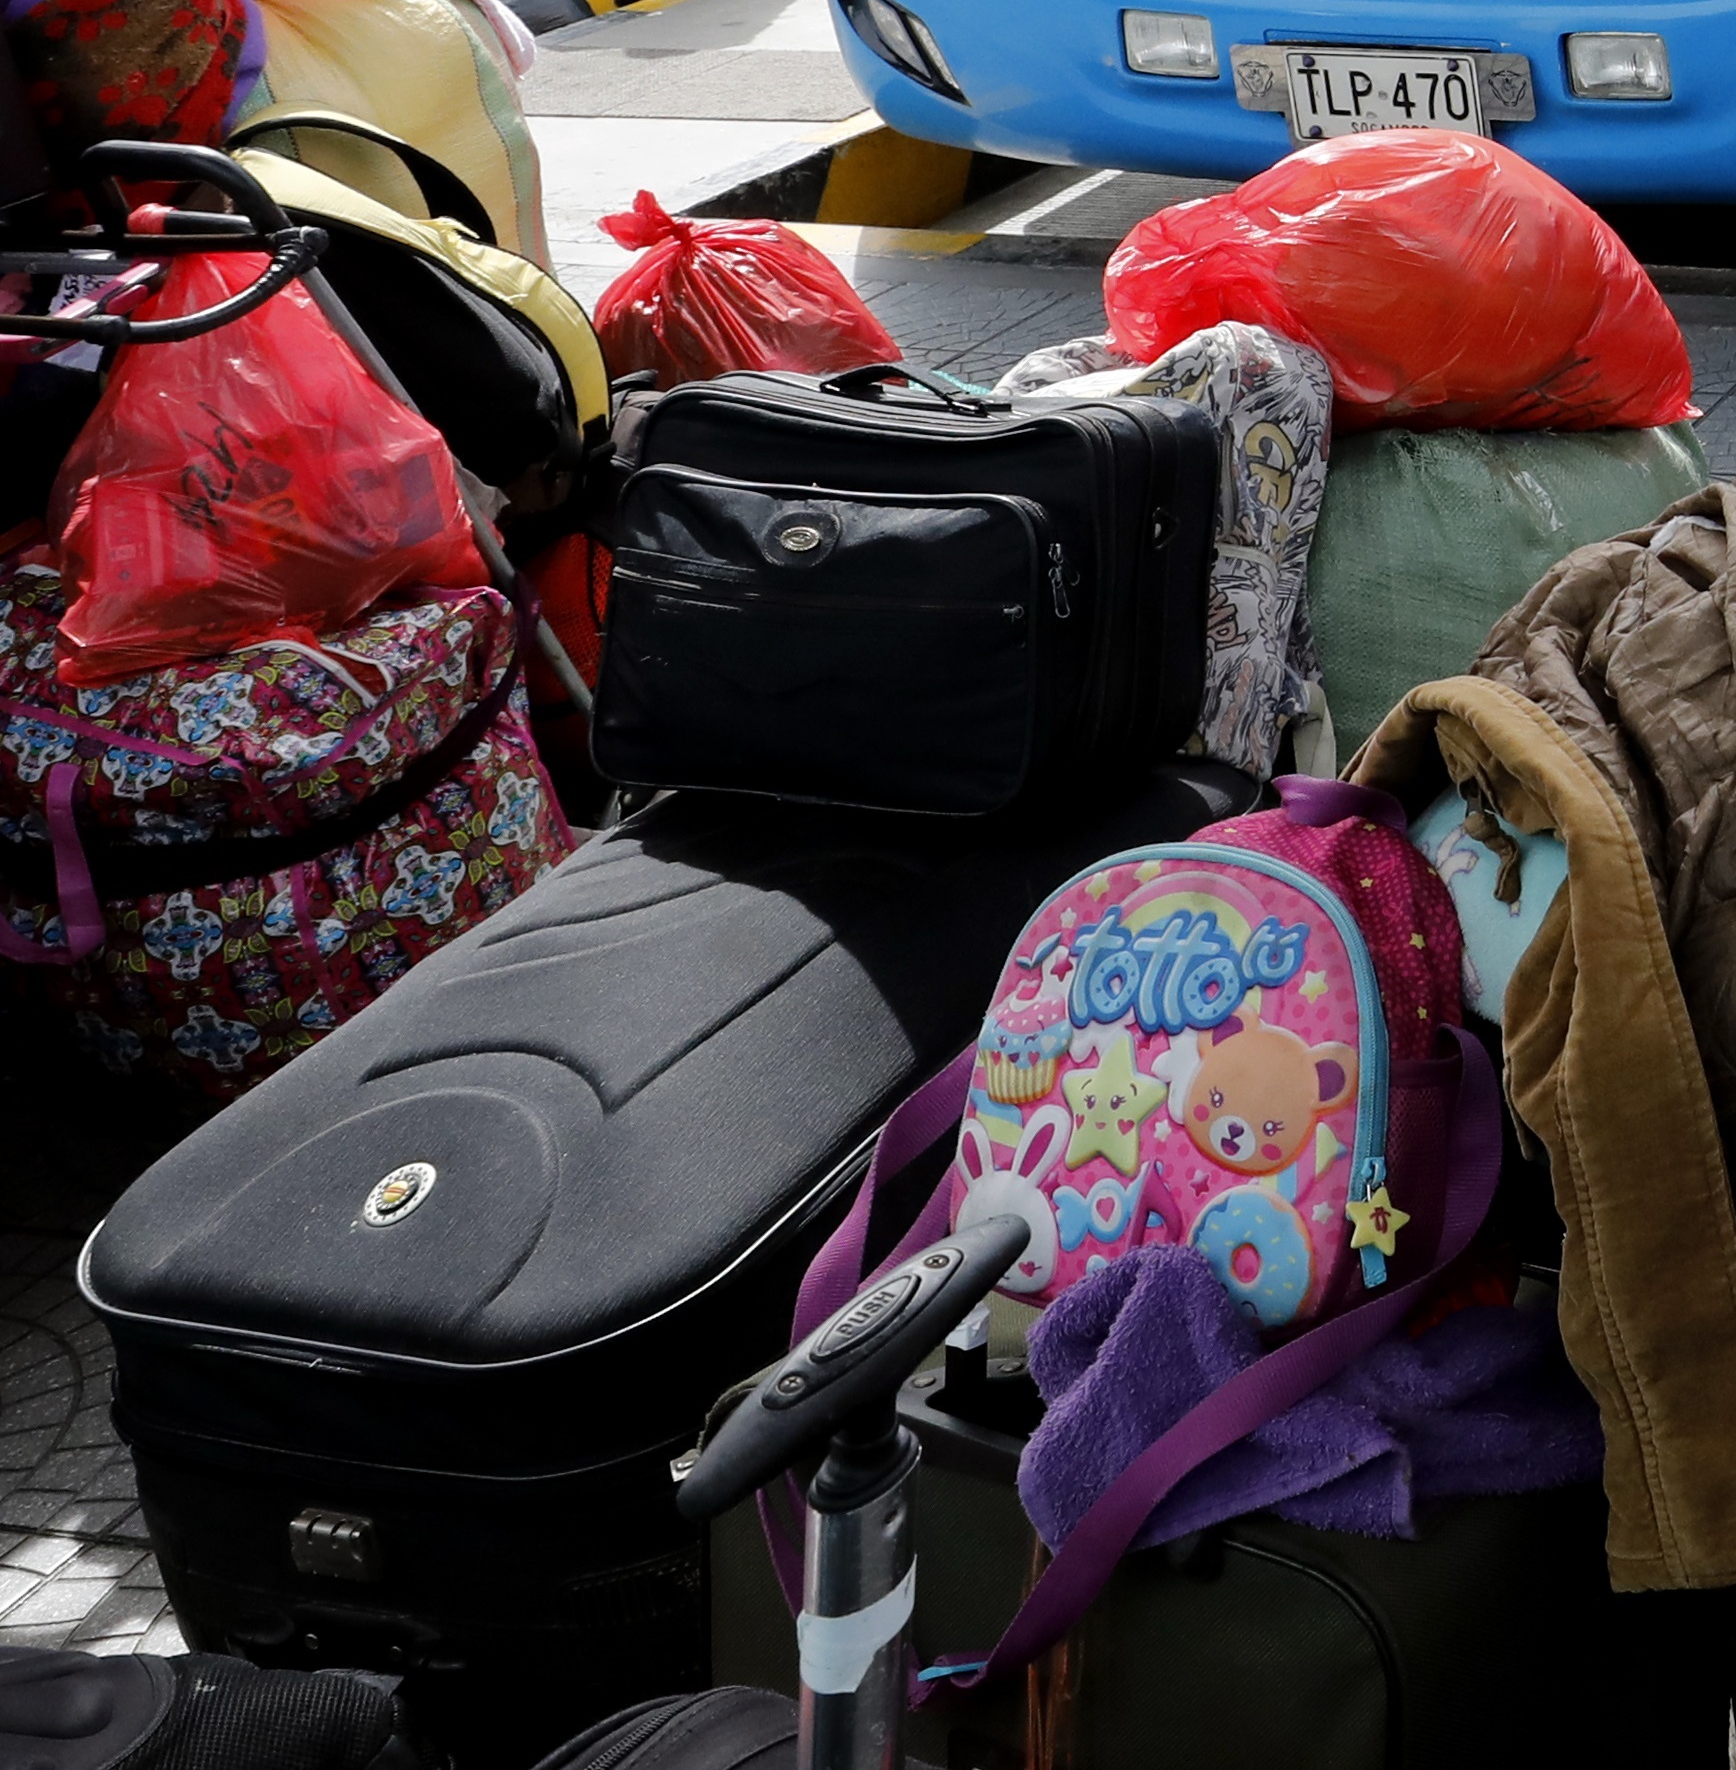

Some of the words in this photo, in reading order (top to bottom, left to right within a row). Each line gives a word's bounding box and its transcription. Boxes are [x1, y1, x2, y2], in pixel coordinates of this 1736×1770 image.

[1297, 68, 1373, 117] TLP
[1392, 72, 1470, 121] 470
[1068, 904, 1243, 1033] totto
[836, 1290, 896, 1337] PUSH
